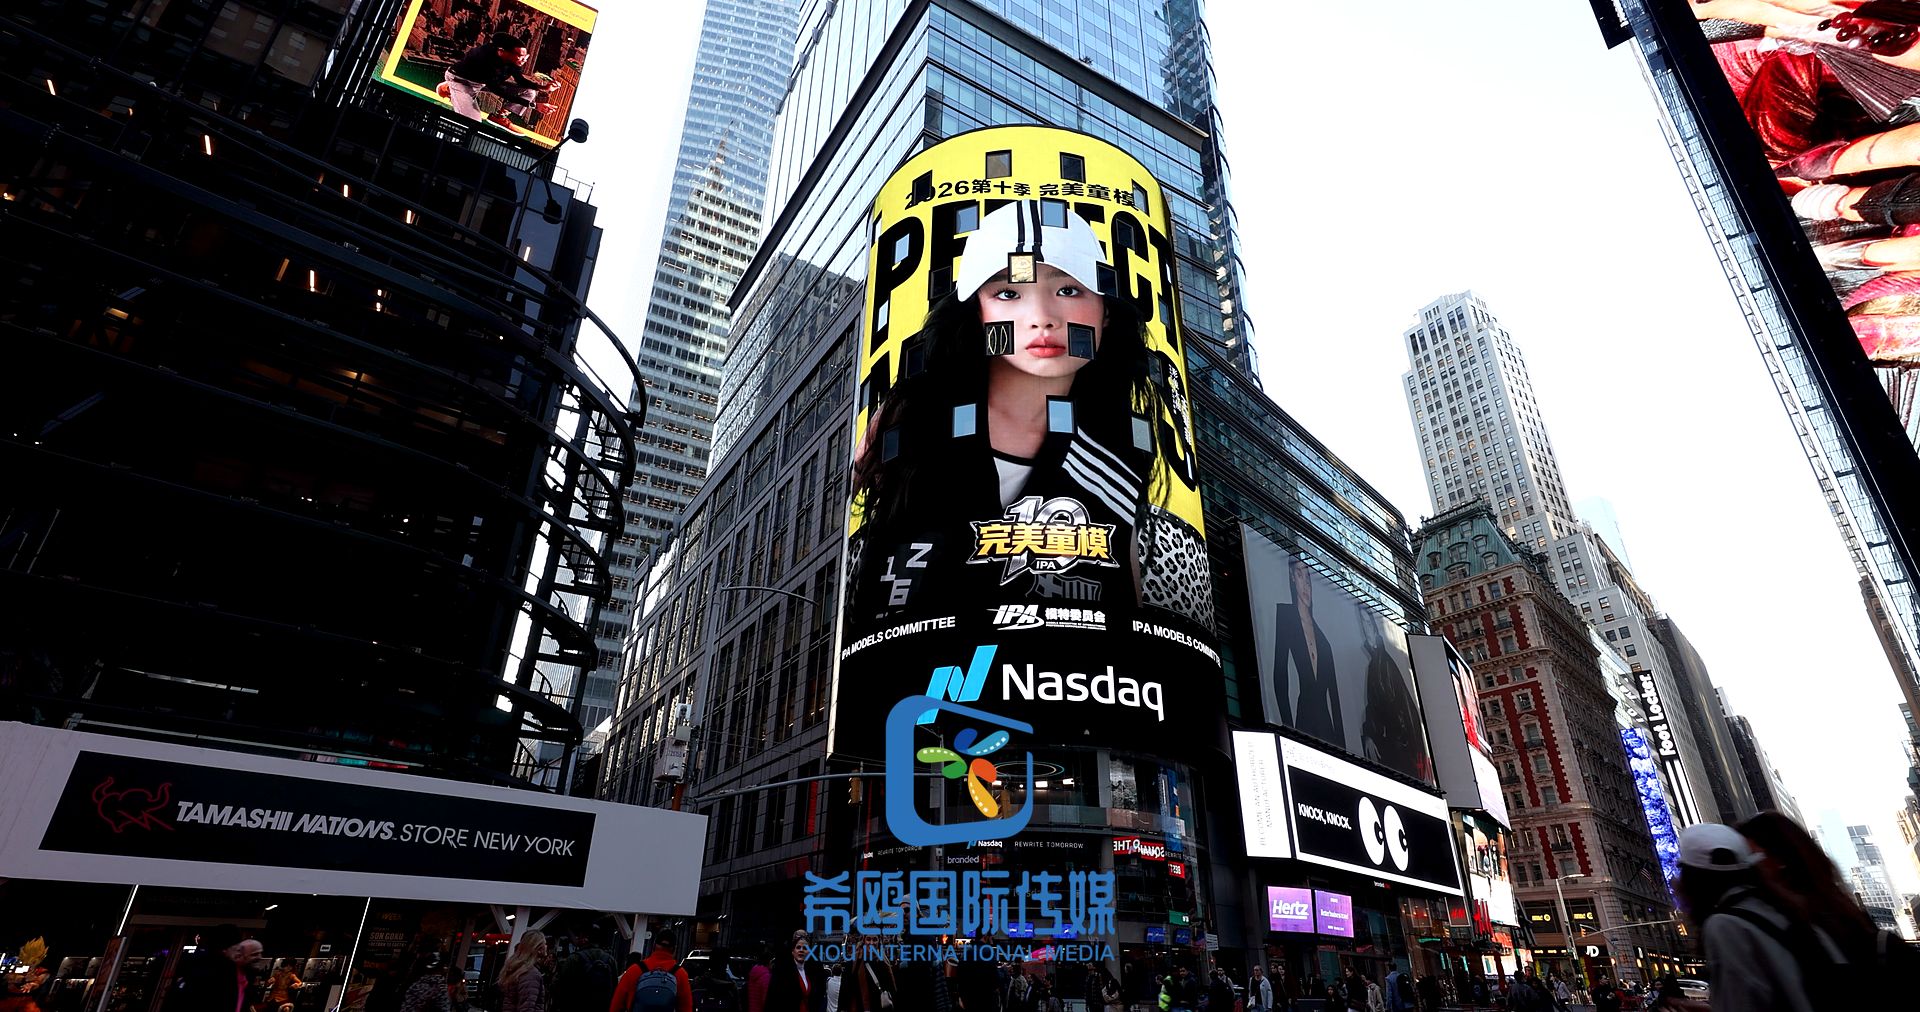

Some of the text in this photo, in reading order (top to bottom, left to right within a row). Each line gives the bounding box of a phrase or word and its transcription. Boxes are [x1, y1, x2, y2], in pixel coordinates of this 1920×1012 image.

[1040, 182, 1139, 211] 完美童模
[977, 523, 1110, 559] 完美童模
[1036, 561, 1056, 570] IPA
[993, 604, 1039, 624] IPA
[841, 616, 956, 661] IPA MODELS COMMITTEE
[1132, 620, 1152, 635] IPA
[1153, 624, 1192, 647] MODELS
[1002, 663, 1165, 725] Nasdaq
[1639, 673, 1665, 722] Locker
[176, 801, 576, 857] TAMASHII NATIONS STORE NEW YORK
[1297, 802, 1352, 830] KNOCK, KNOCK.
[978, 840, 1003, 848] Nasdaq
[1046, 841, 1084, 849] TOMORROW
[947, 855, 980, 864] branded
[1272, 899, 1309, 916] Hertz
[1586, 945, 1600, 958] JD
